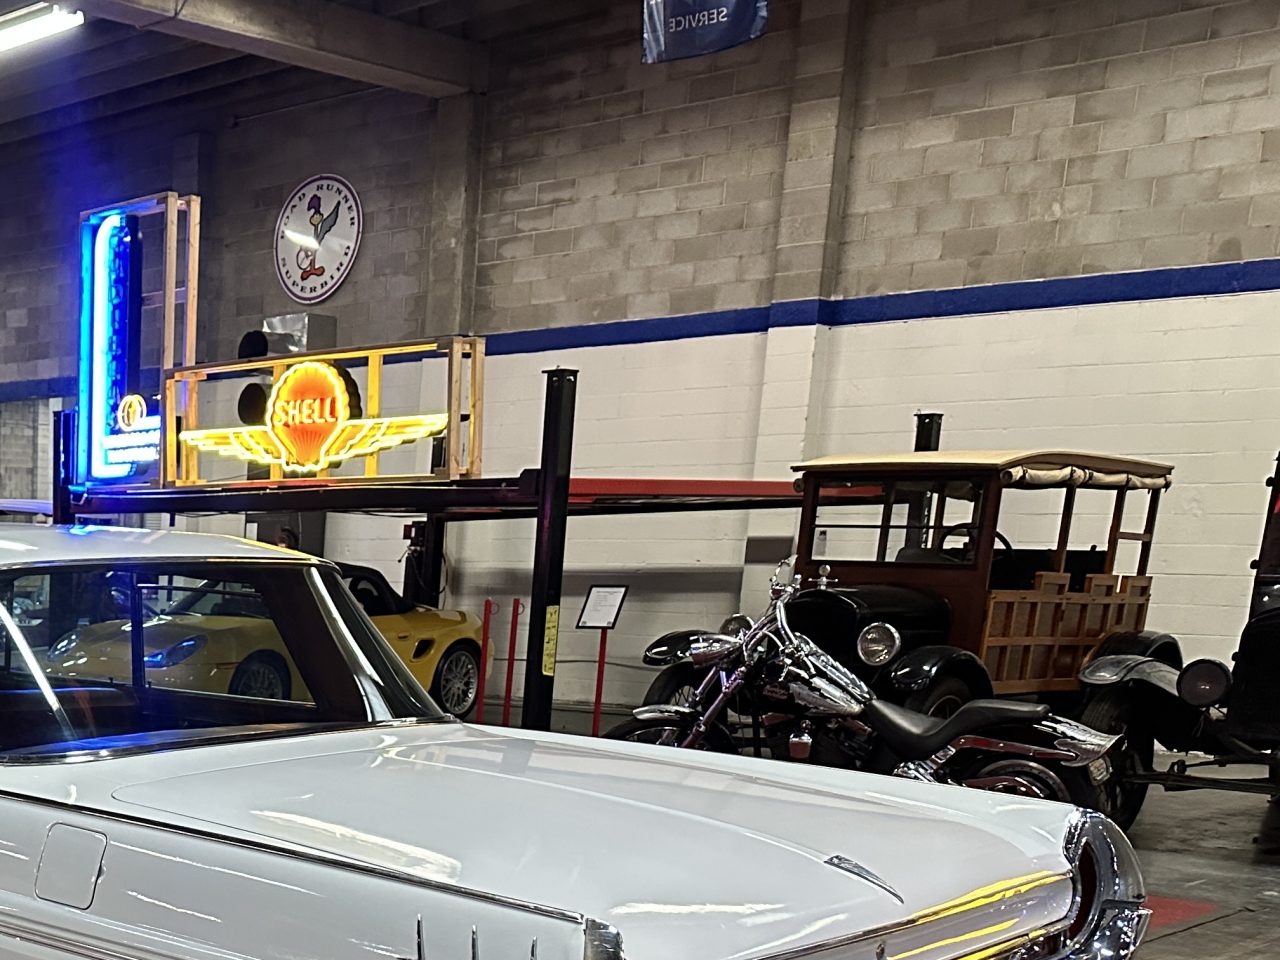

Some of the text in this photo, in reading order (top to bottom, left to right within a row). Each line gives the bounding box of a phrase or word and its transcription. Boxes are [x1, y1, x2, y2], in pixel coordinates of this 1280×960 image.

[280, 184, 356, 239] ROAD RUNNER
[281, 245, 351, 293] SUPERBIRD
[274, 397, 337, 426] SHELL
